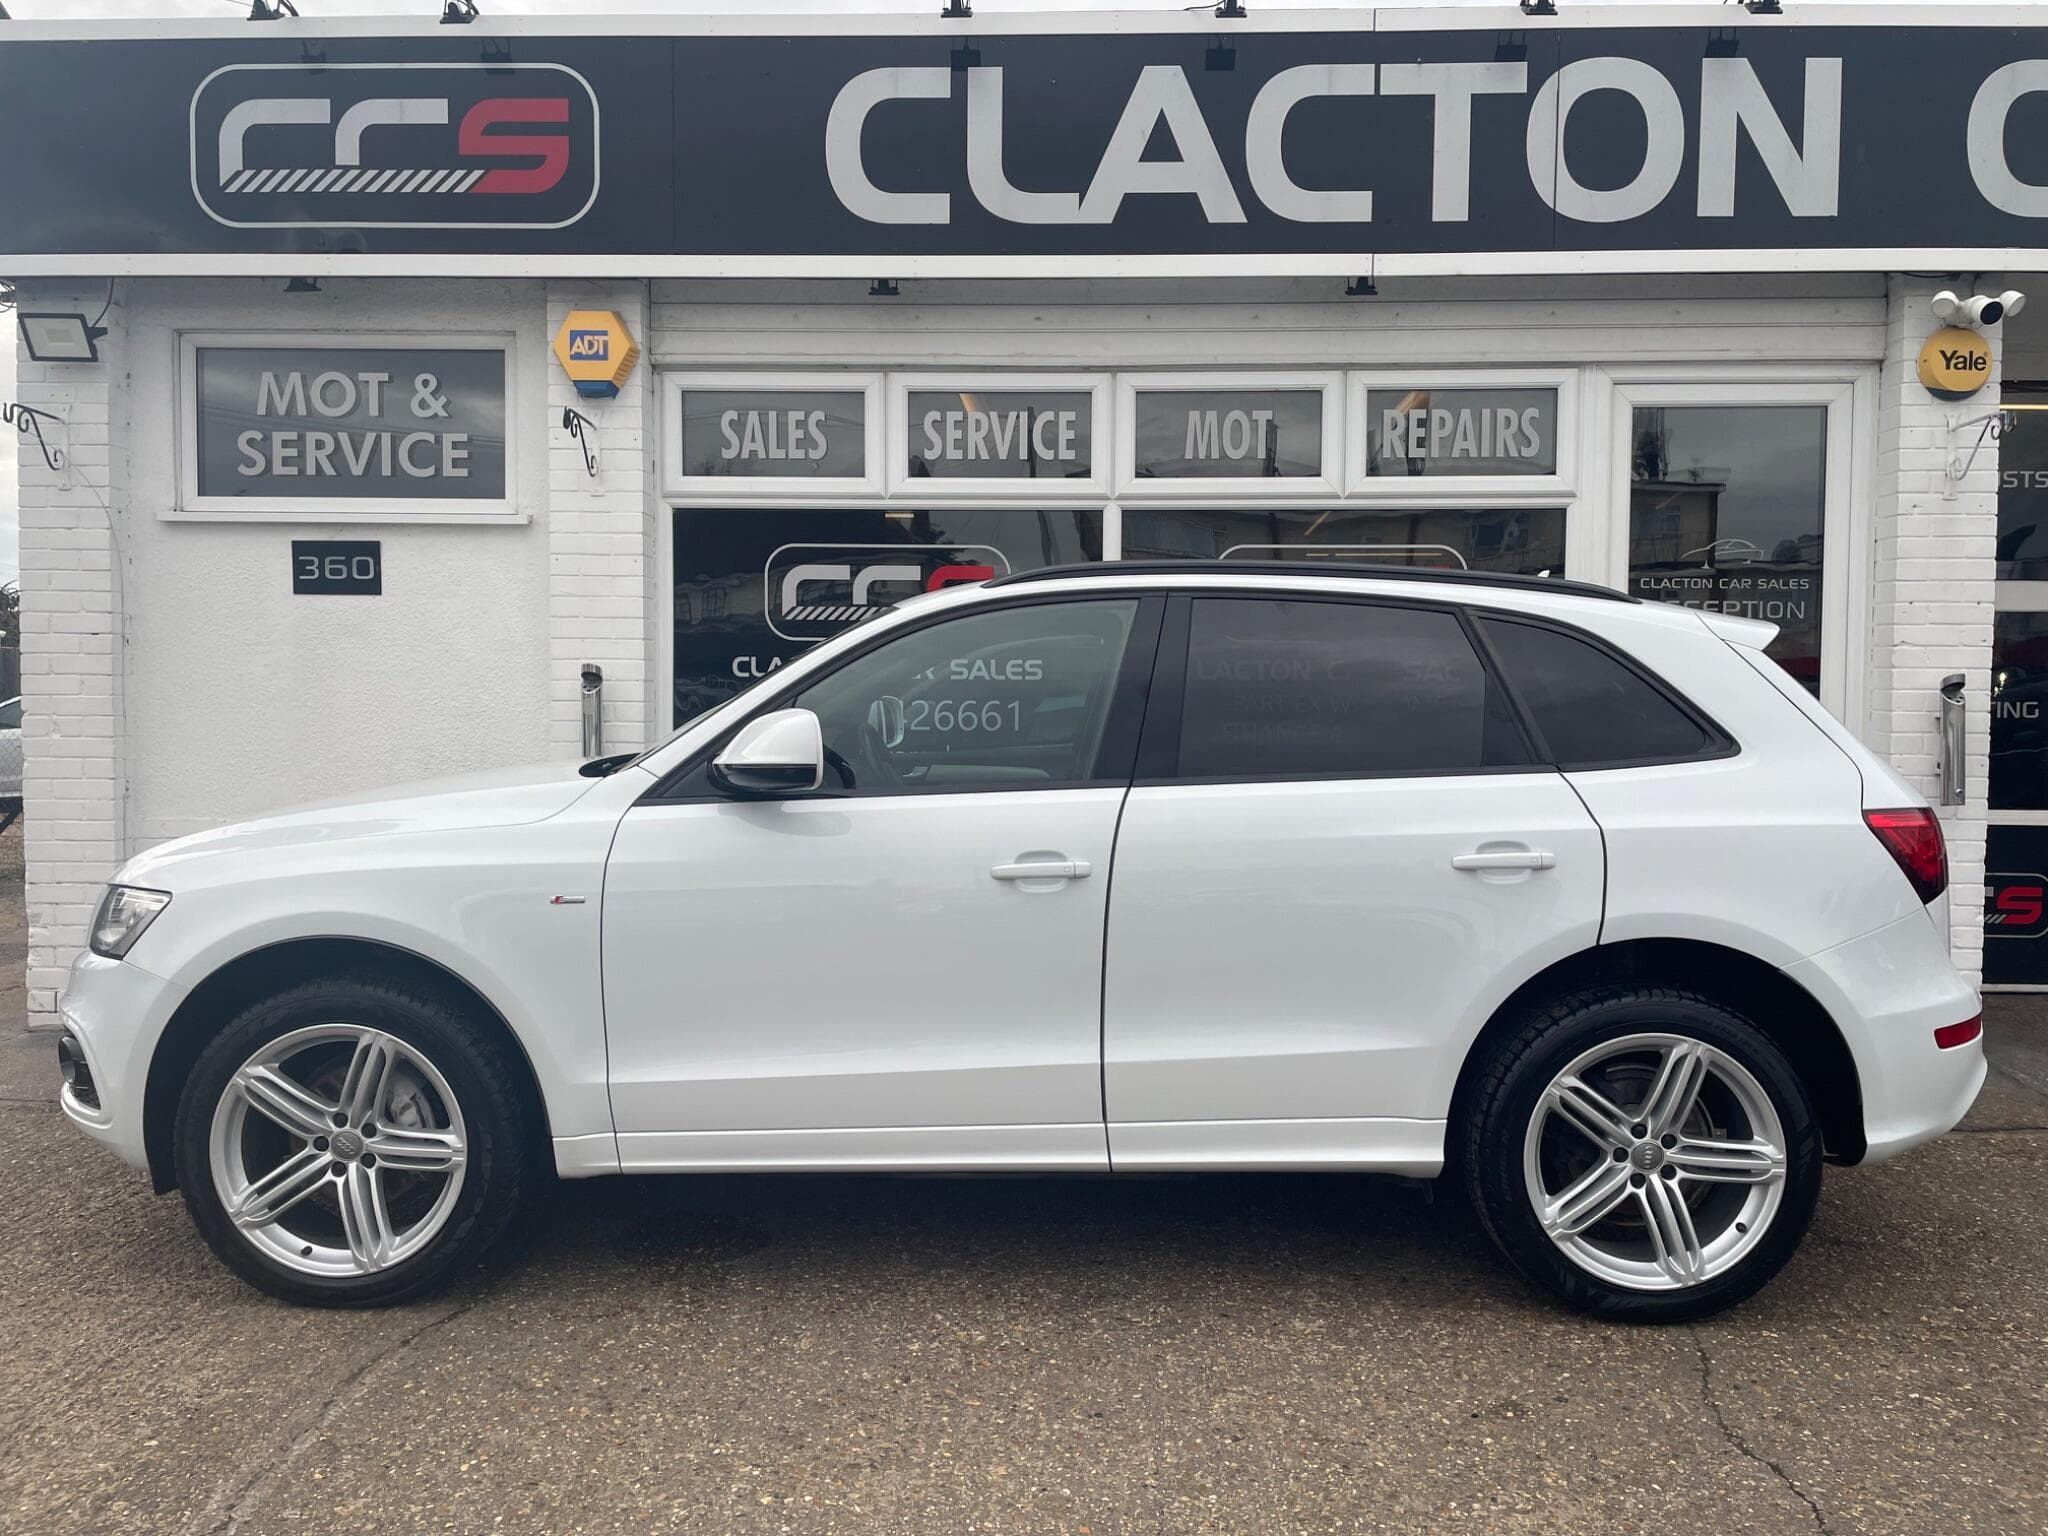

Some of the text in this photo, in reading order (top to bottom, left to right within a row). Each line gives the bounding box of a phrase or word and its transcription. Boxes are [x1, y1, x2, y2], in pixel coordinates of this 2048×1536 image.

[825, 56, 1842, 225] CLACTON
[570, 335, 608, 356] ADT
[1939, 350, 1987, 371] Yale
[256, 371, 449, 418] MOT &
[237, 430, 470, 478] SERVICE
[720, 410, 827, 460] SALES
[923, 410, 1077, 461] SERVICE
[1184, 410, 1273, 460] MOT
[1382, 408, 1541, 459] REPAIRS
[298, 556, 375, 580] 360
[1640, 578, 1809, 589] CLACTON CAR SALES
[950, 659, 1042, 681] SALES
[900, 700, 1022, 732] 26661
